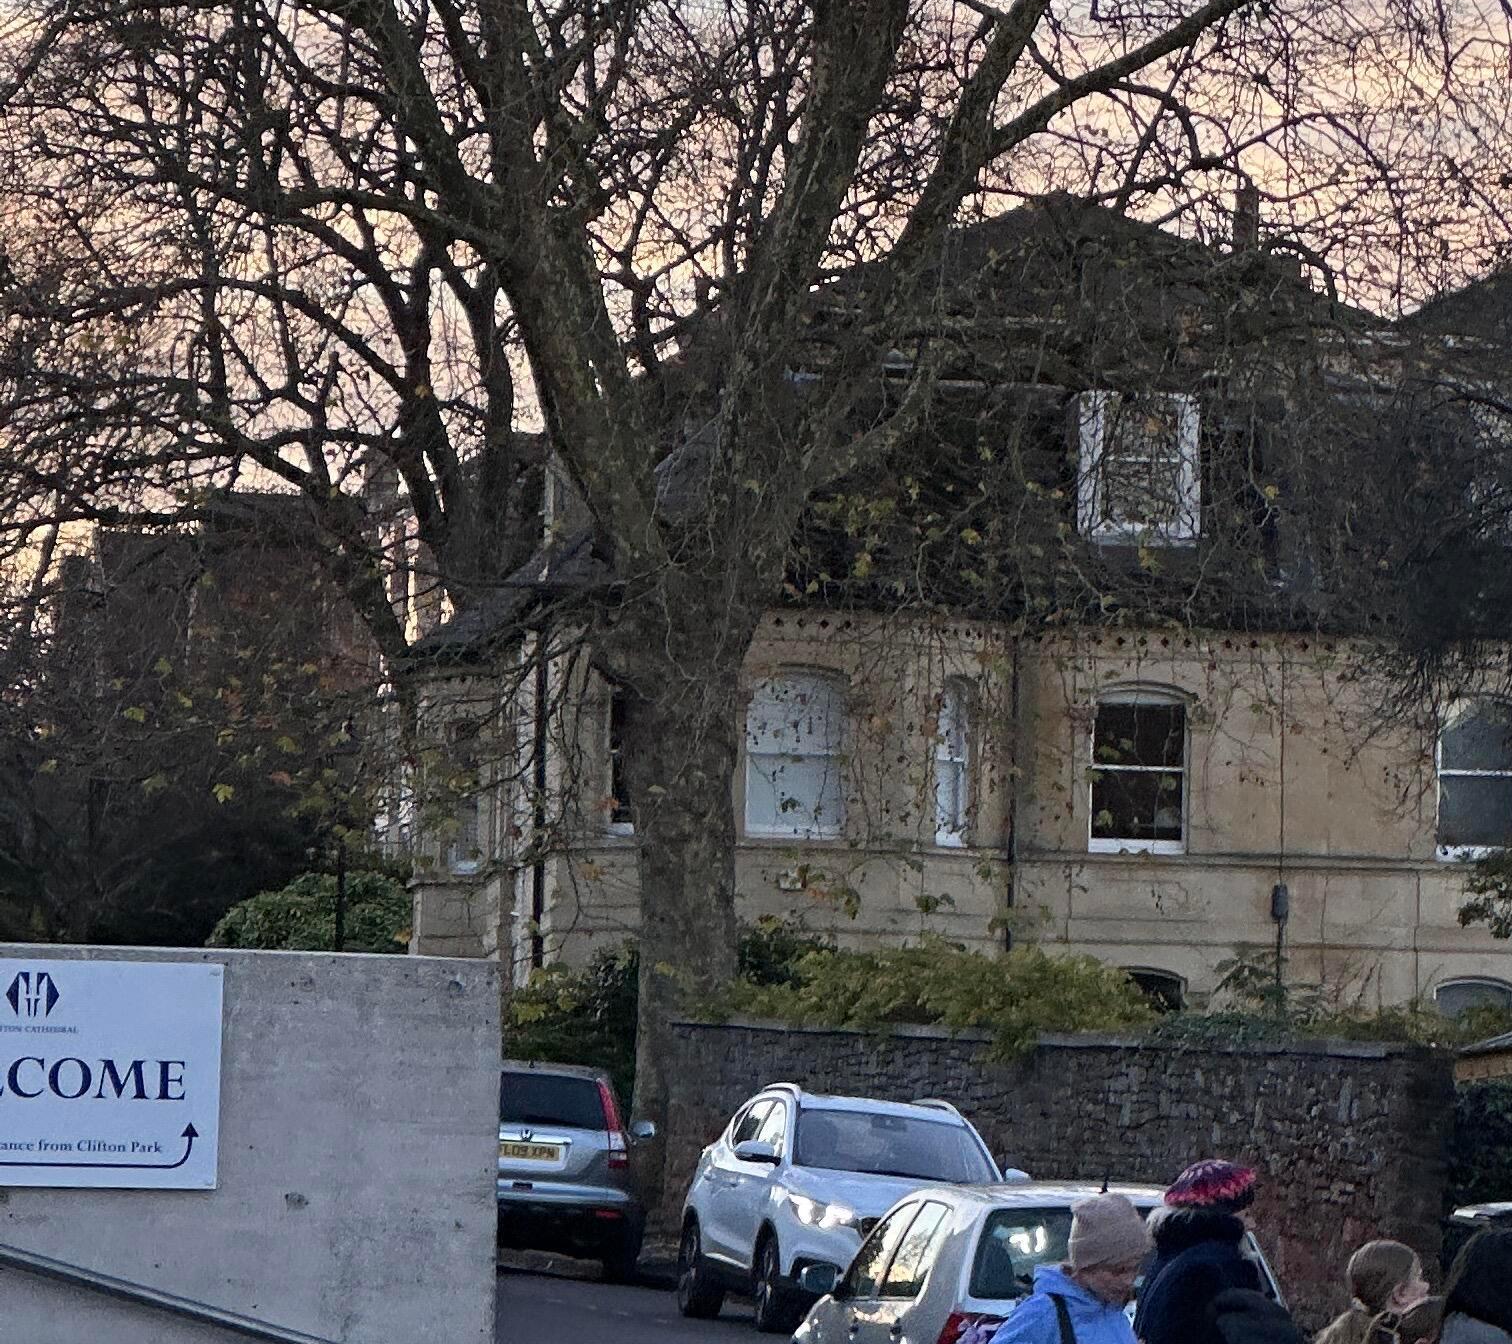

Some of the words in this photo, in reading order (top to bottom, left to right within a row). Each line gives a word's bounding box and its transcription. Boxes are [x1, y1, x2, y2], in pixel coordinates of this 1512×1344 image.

[0, 1056, 186, 1100] COME
[0, 1142, 34, 1152] ance
[38, 1139, 72, 1152] from
[77, 1139, 126, 1153] Clifton
[131, 1141, 162, 1153] Park
